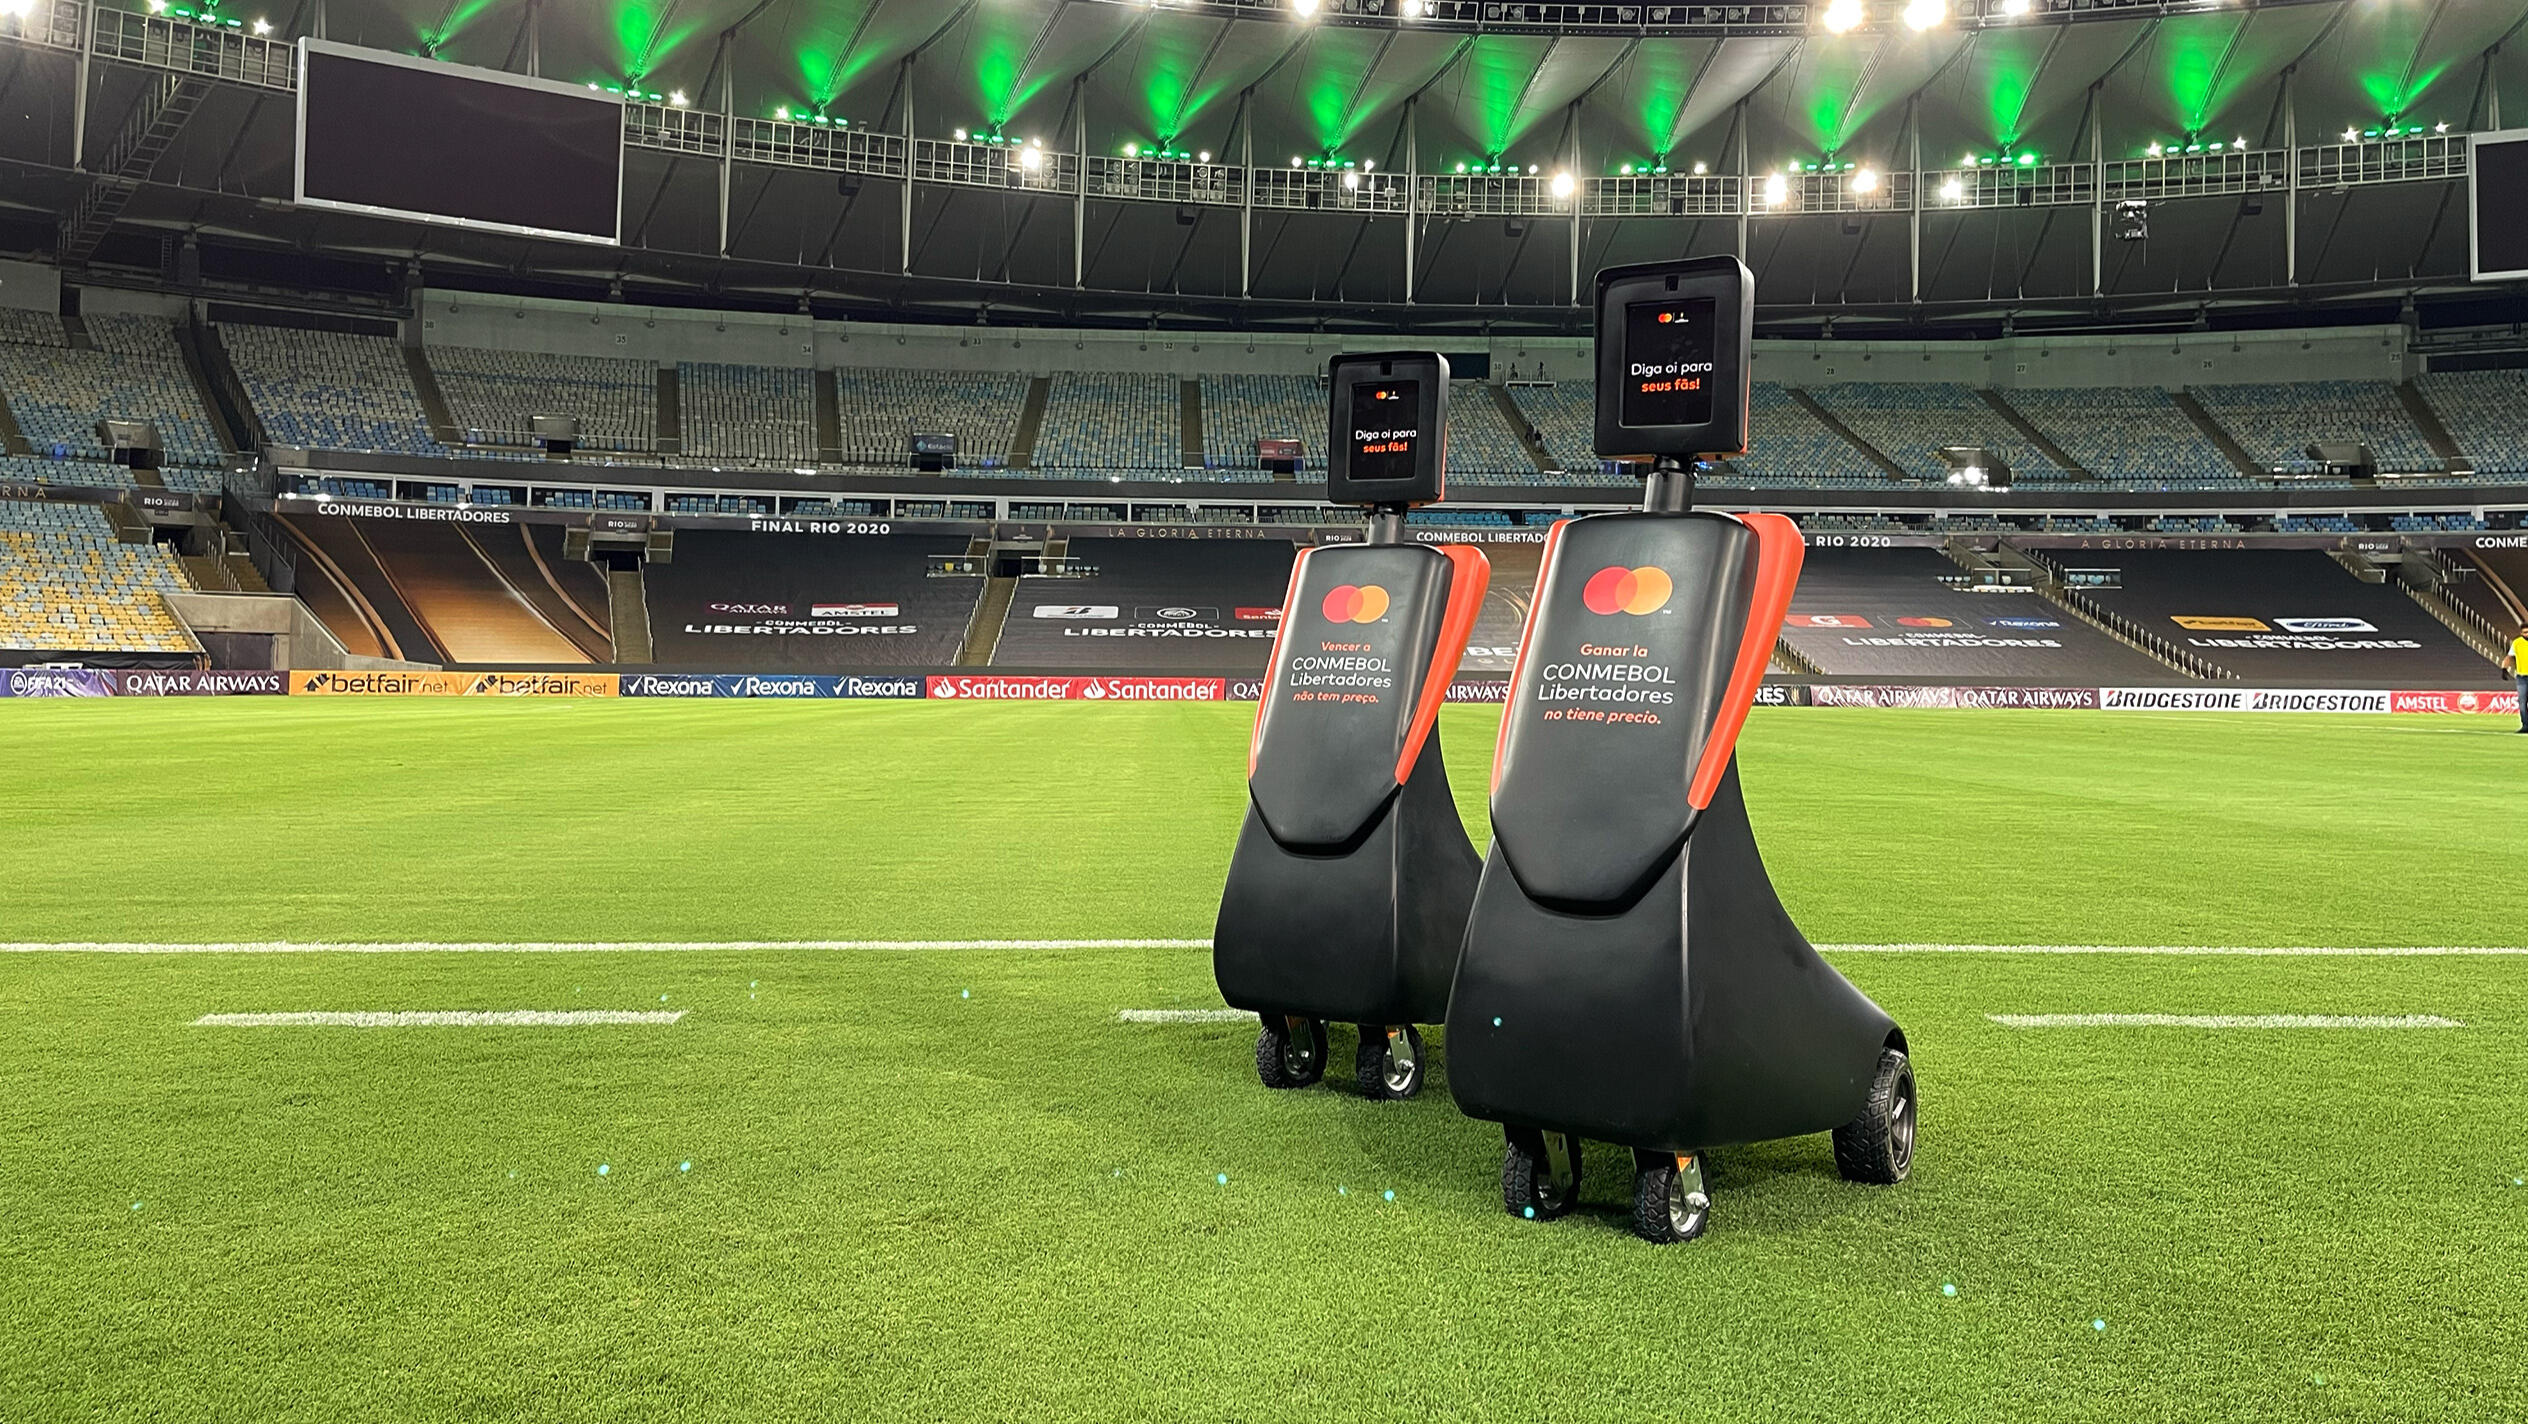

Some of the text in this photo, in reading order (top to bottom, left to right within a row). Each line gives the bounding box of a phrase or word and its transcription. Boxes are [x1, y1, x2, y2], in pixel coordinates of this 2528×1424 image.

[1631, 361, 1713, 378] Diga oi para
[1641, 378, 1700, 393] seus fãs!
[1355, 429, 1417, 441] Diga oi para
[1363, 441, 1408, 453] seus fãs!
[144, 497, 162, 506] RIO
[317, 503, 510, 524] CONMEBOL LIBERTADORES
[608, 520, 624, 528] RIO
[751, 520, 890, 535] FINAL RIO 2020
[1108, 528, 1266, 539] LA GLORIA ETERNA
[1416, 532, 1485, 543] CONMEBOL
[1816, 535, 1844, 547] RIO
[1850, 536, 1891, 547] 2020
[2081, 540, 2090, 549] A
[2179, 539, 2246, 549] ETERNA
[2475, 537, 2528, 548] CONME
[685, 624, 918, 635] LIBERTADORES
[1064, 628, 1278, 638] LIBERTADORES
[1321, 641, 1371, 652] Vencer a
[1580, 643, 1649, 657] Ganar la
[1843, 637, 2063, 648] LIBERTADORES
[2188, 638, 2422, 650] LIBERTADORES
[1292, 656, 1392, 673] CONMEBOL
[1290, 672, 1392, 688] Libertadores
[1542, 663, 1677, 684] CONMEBOL
[126, 675, 280, 693] QATAR AIRWAYS
[644, 677, 713, 695] Rexona
[746, 677, 815, 696] Rexona
[849, 678, 916, 696] Rexona
[959, 679, 1070, 699] Santander
[1109, 681, 1218, 700] Santander
[1293, 690, 1379, 704] não tem preço.
[1538, 683, 1675, 705] Libertadores
[1818, 688, 1949, 705] QATAR AIRWAYS
[1964, 689, 2092, 706] QATAR AIRWAYS
[2106, 690, 2242, 709] BRIDGESTONE
[2253, 691, 2386, 711] BRIDGESTONE
[2396, 697, 2448, 710] AMSTEL
[1543, 707, 1661, 725] no tiene precio.
